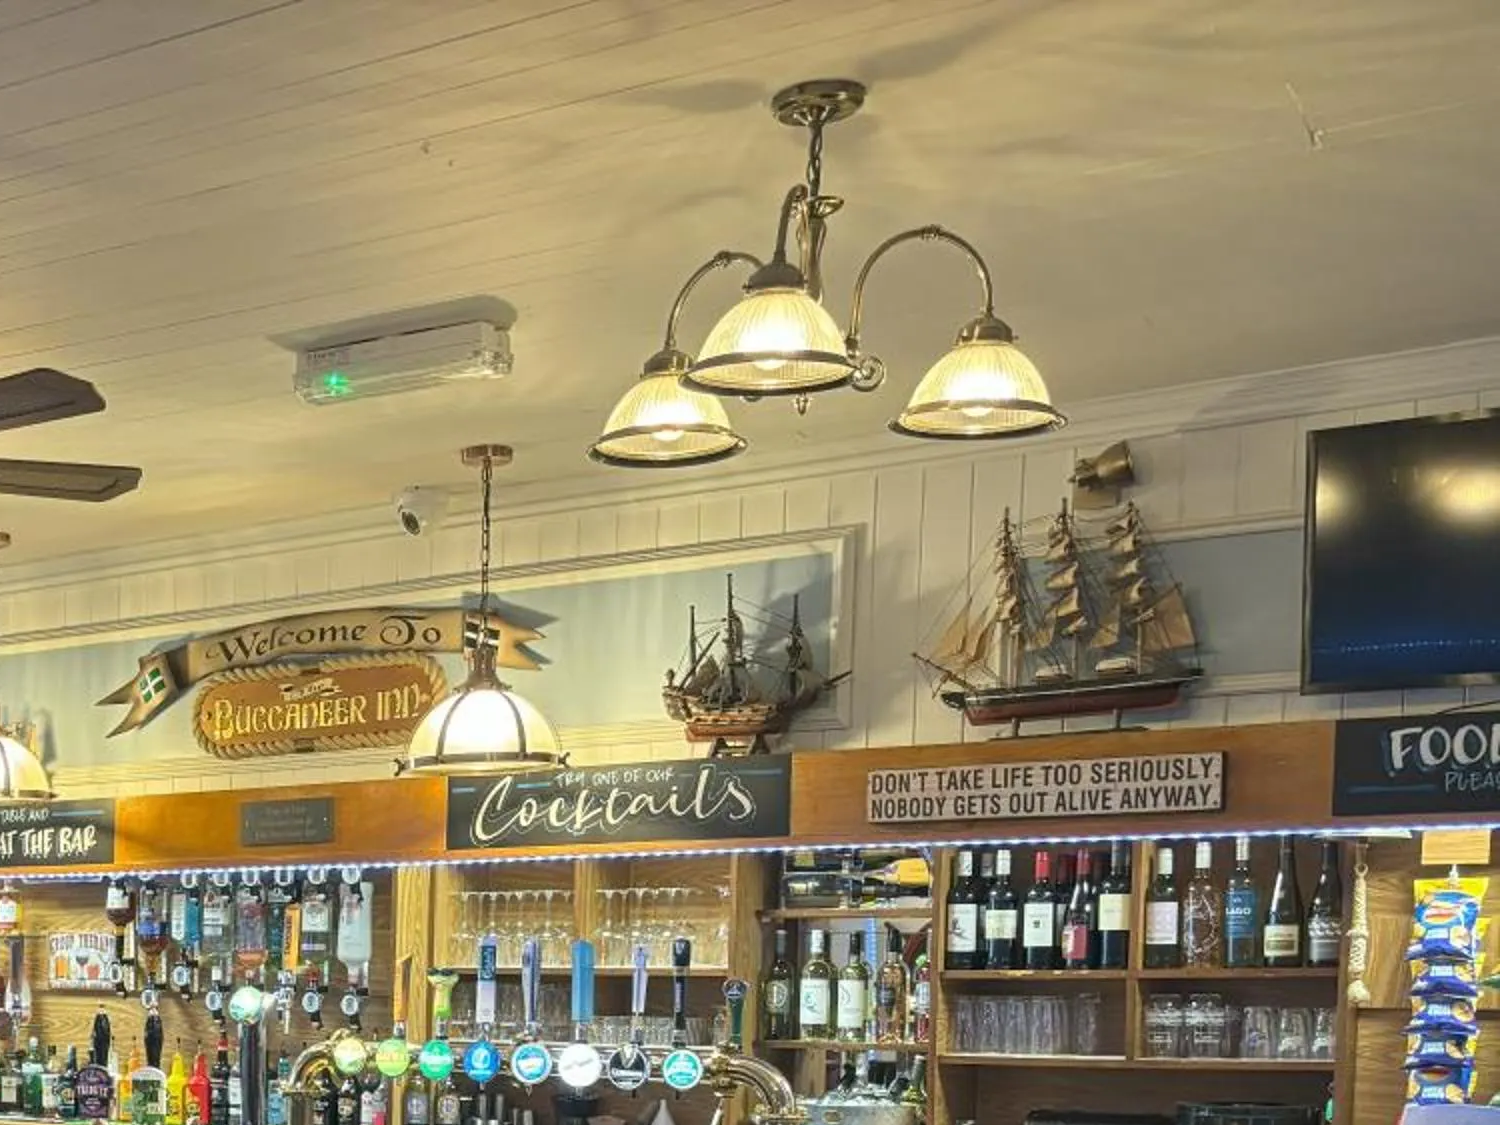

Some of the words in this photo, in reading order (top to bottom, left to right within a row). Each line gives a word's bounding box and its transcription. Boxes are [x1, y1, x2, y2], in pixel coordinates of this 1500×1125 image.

[205, 620, 368, 662] Welcome
[379, 615, 442, 647] To
[1389, 723, 1500, 770] FOO
[592, 770, 619, 787] ONE
[622, 769, 642, 785] OF
[646, 767, 675, 783] OUR
[871, 769, 929, 795] DON'T
[935, 768, 984, 793] TAKE
[991, 765, 1033, 789] LIFE
[1041, 762, 1082, 787] TOO
[1090, 757, 1221, 784] SERIOUSLY.
[473, 763, 755, 842] Cocktails
[871, 795, 947, 819] NOBODY
[953, 793, 1002, 817] GETS
[1009, 791, 1048, 815] OUT
[1054, 787, 1113, 813] ALIVE
[1119, 783, 1221, 811] ANYWAY.
[20, 827, 56, 858] THE
[58, 824, 98, 855] BAR
